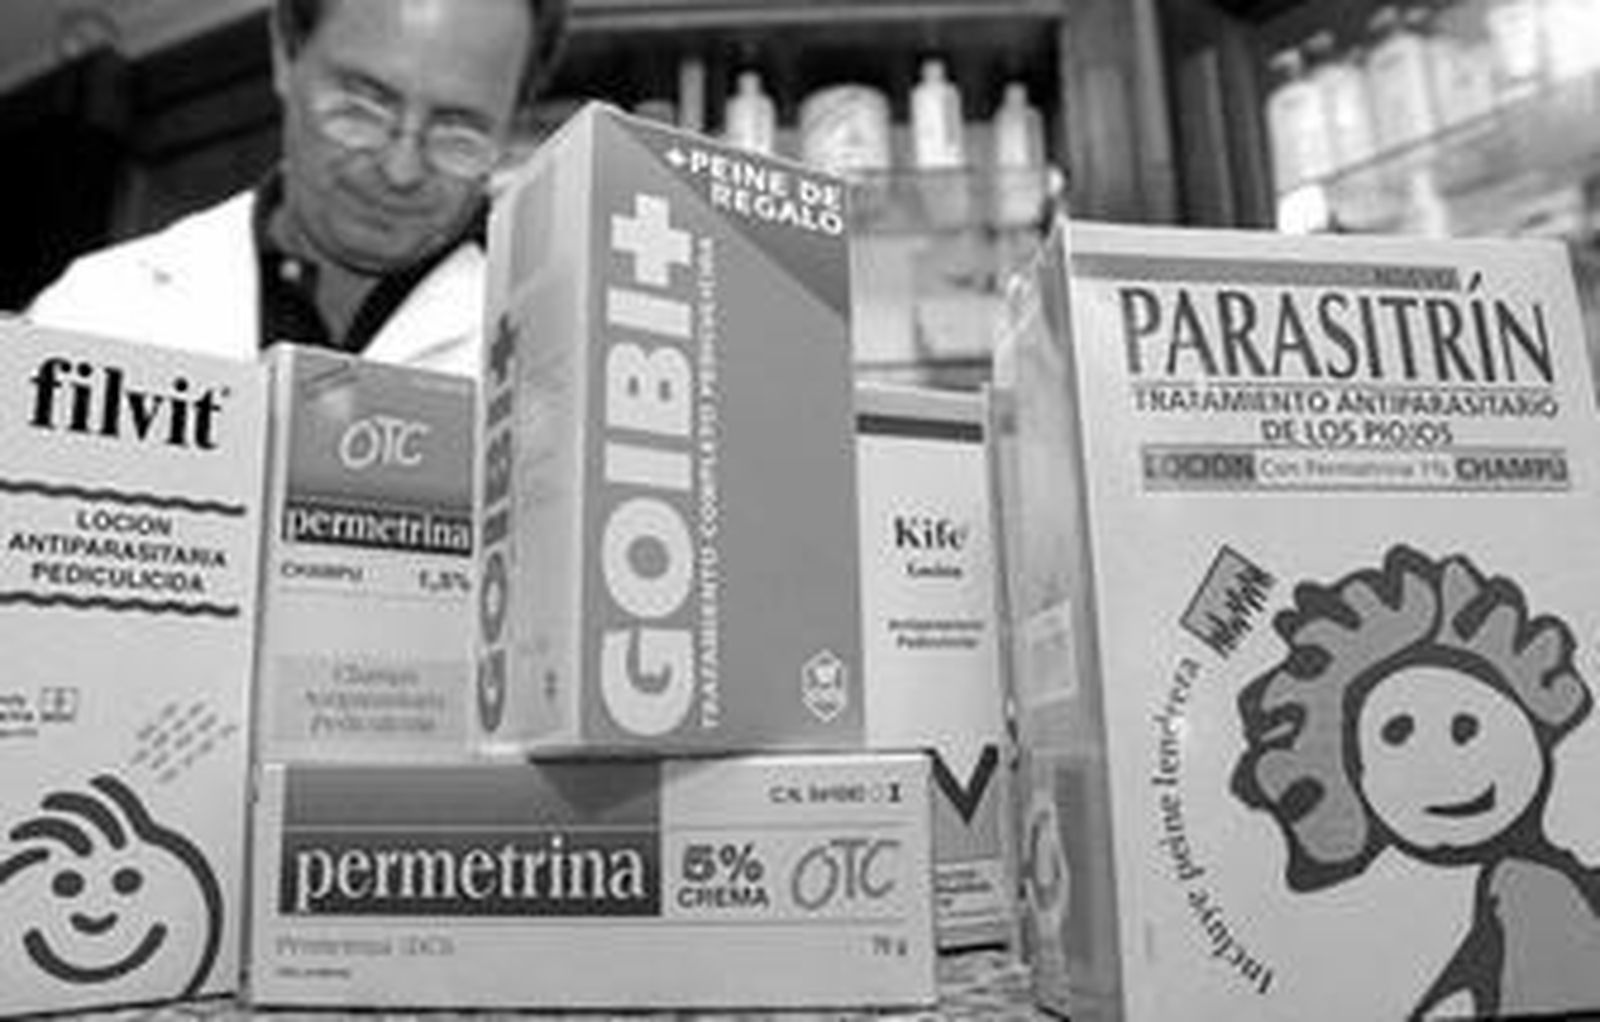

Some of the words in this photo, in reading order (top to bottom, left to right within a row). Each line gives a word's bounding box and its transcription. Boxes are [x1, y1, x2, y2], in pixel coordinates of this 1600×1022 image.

[711, 182, 843, 235] REGALO
[800, 179, 842, 211] DE
[1118, 271, 1556, 383] PARASITRÍN
[1135, 390, 1330, 414] TRATAMIENTO
[1335, 392, 1558, 419] ANTIPARASITARIO
[338, 414, 431, 468] OTC
[1261, 419, 1297, 442] DE
[1303, 419, 1358, 444] LOS
[1364, 420, 1454, 446] PIOJOS
[8, 533, 227, 568] ANTIPARASITARIA
[284, 505, 470, 551] permetrina
[31, 561, 205, 592] PEDICULICIDA
[1158, 794, 1206, 882] peine
[297, 836, 646, 912] permetrina
[682, 842, 765, 883] 5%
[791, 837, 903, 911] OTC
[677, 886, 770, 909] CREMA
[1187, 888, 1273, 995] Incluye
